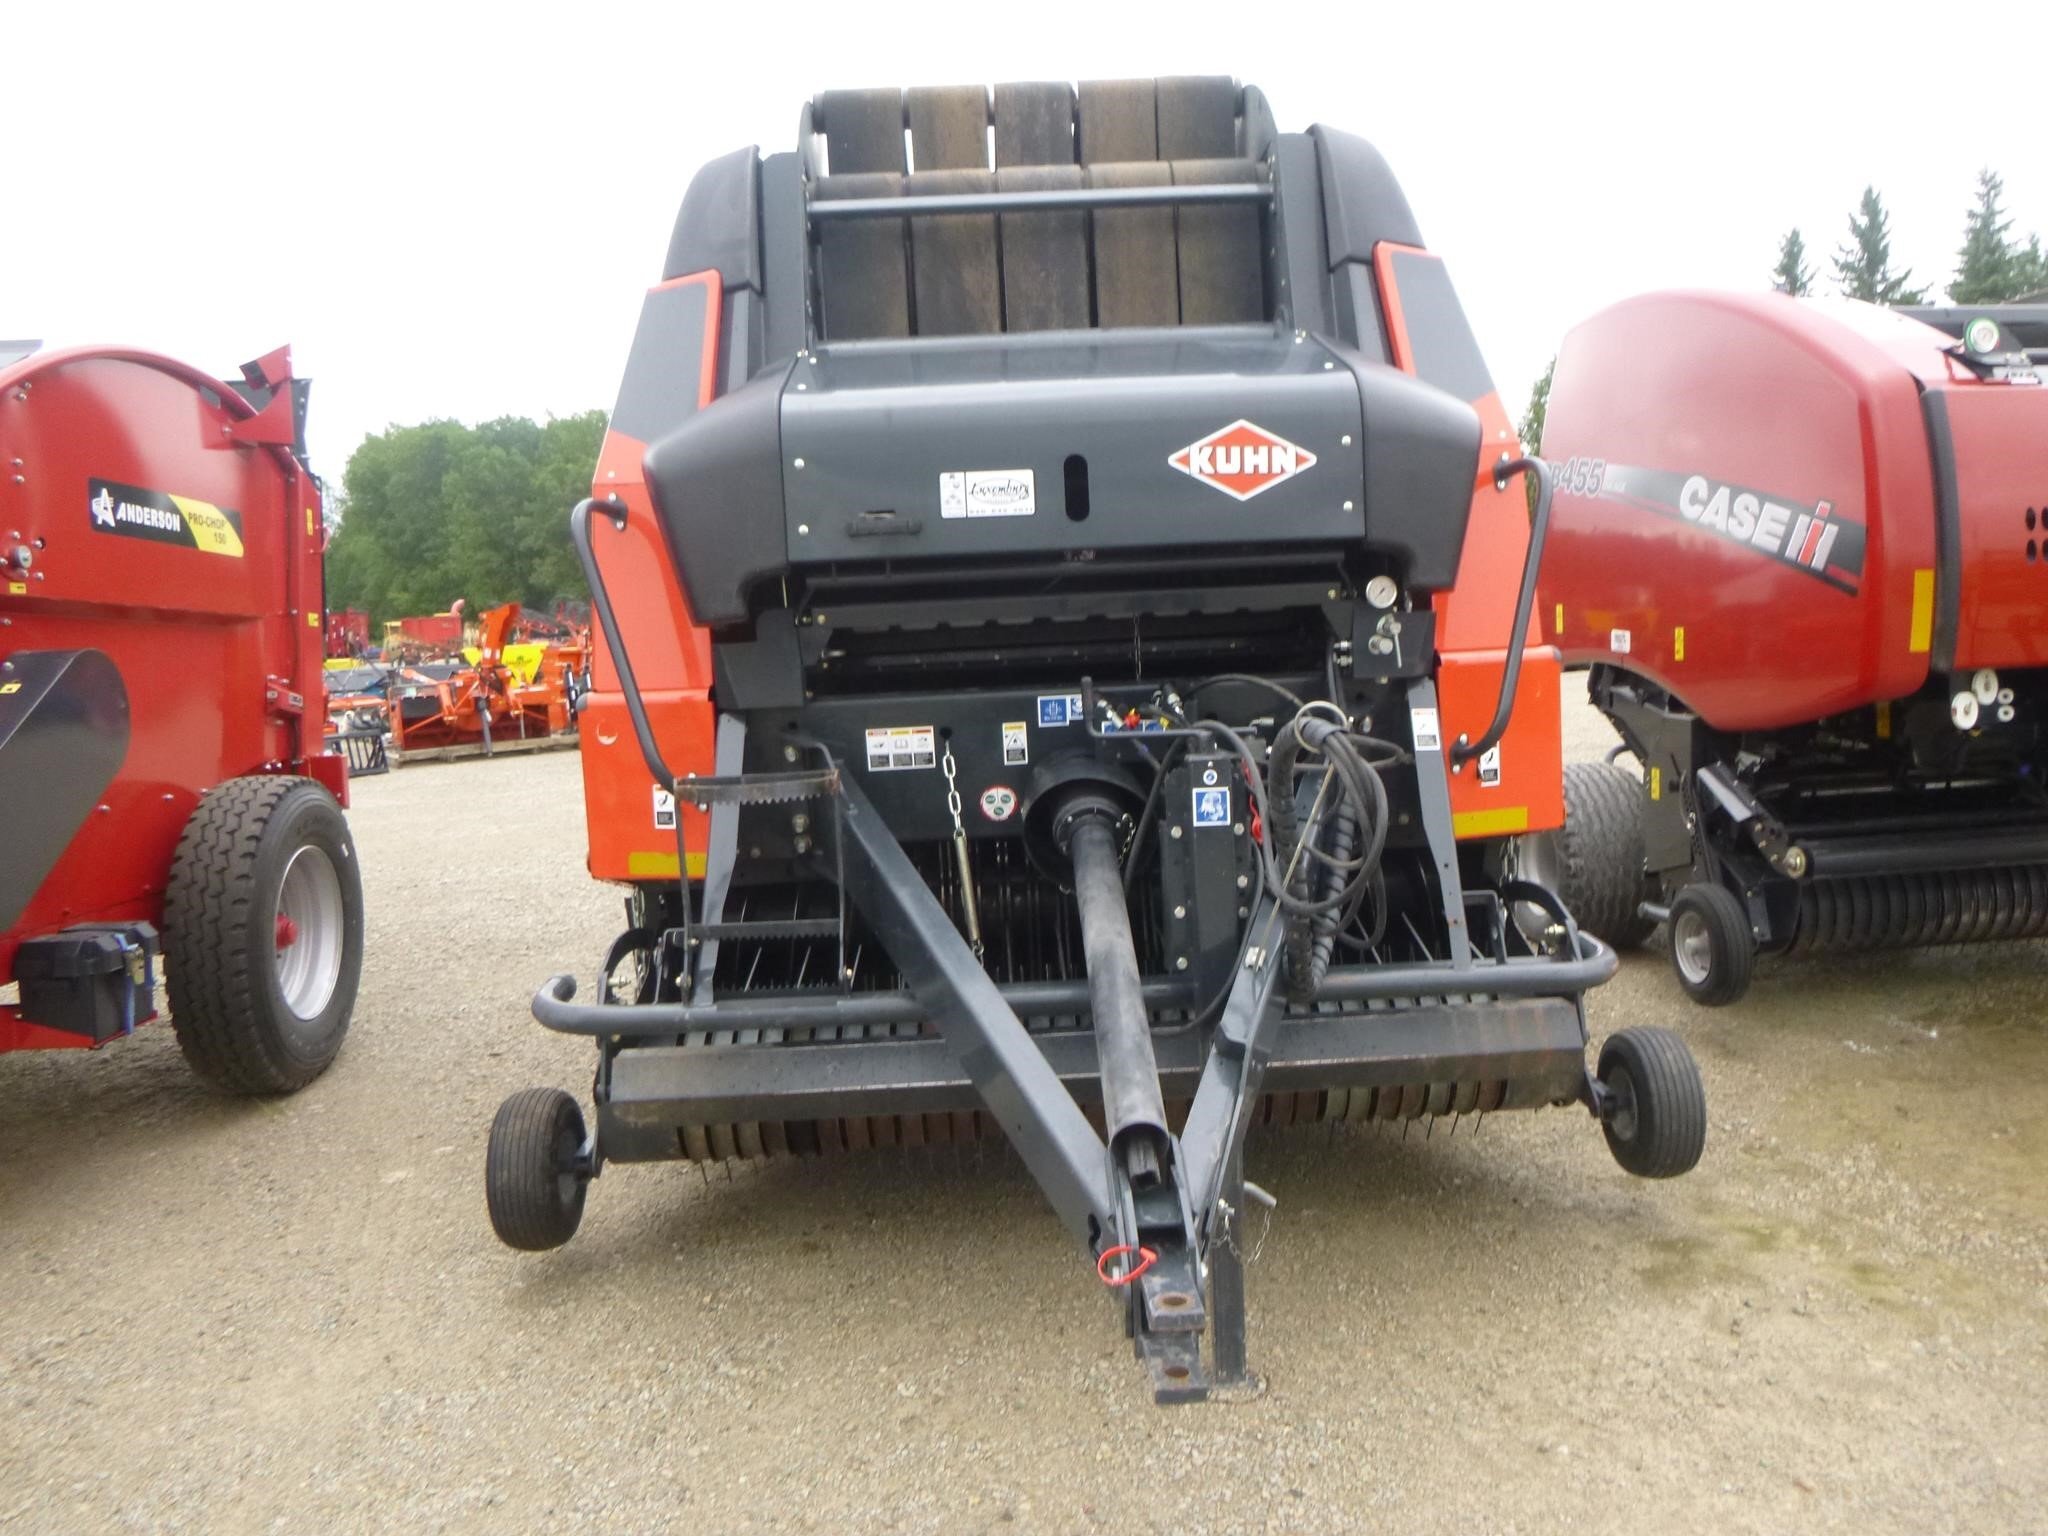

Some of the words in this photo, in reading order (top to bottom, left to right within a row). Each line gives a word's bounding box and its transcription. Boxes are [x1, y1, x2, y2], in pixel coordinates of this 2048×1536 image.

[1190, 445, 1296, 475] KUHN
[116, 502, 181, 532] ANDERSON
[188, 511, 226, 530] PRO-CHOP
[1679, 474, 1792, 554] CASE
